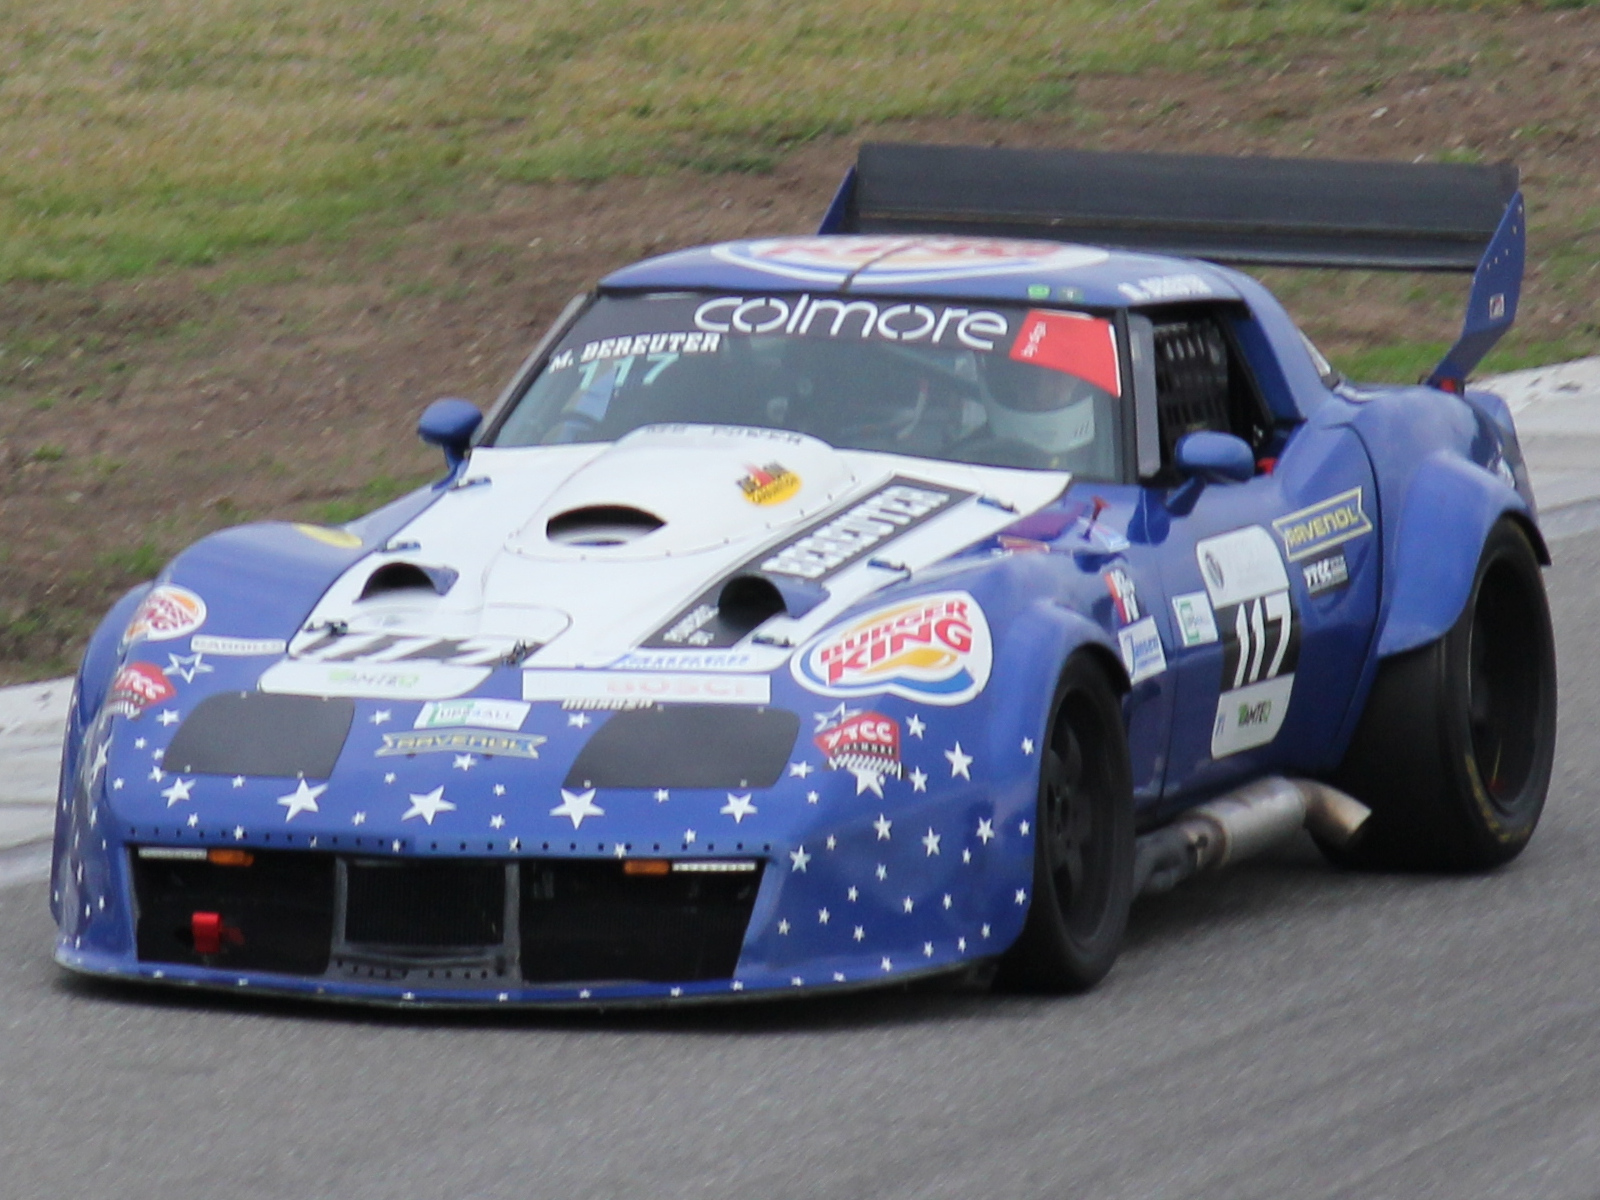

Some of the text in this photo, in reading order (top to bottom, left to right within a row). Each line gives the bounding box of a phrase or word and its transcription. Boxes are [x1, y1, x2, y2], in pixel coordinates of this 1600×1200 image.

[694, 293, 1008, 350] colmore
[577, 353, 679, 390] 117
[1285, 505, 1359, 548] RAVENOL
[820, 600, 968, 665] BURGER
[827, 618, 973, 687] KING
[1233, 590, 1292, 690] 117
